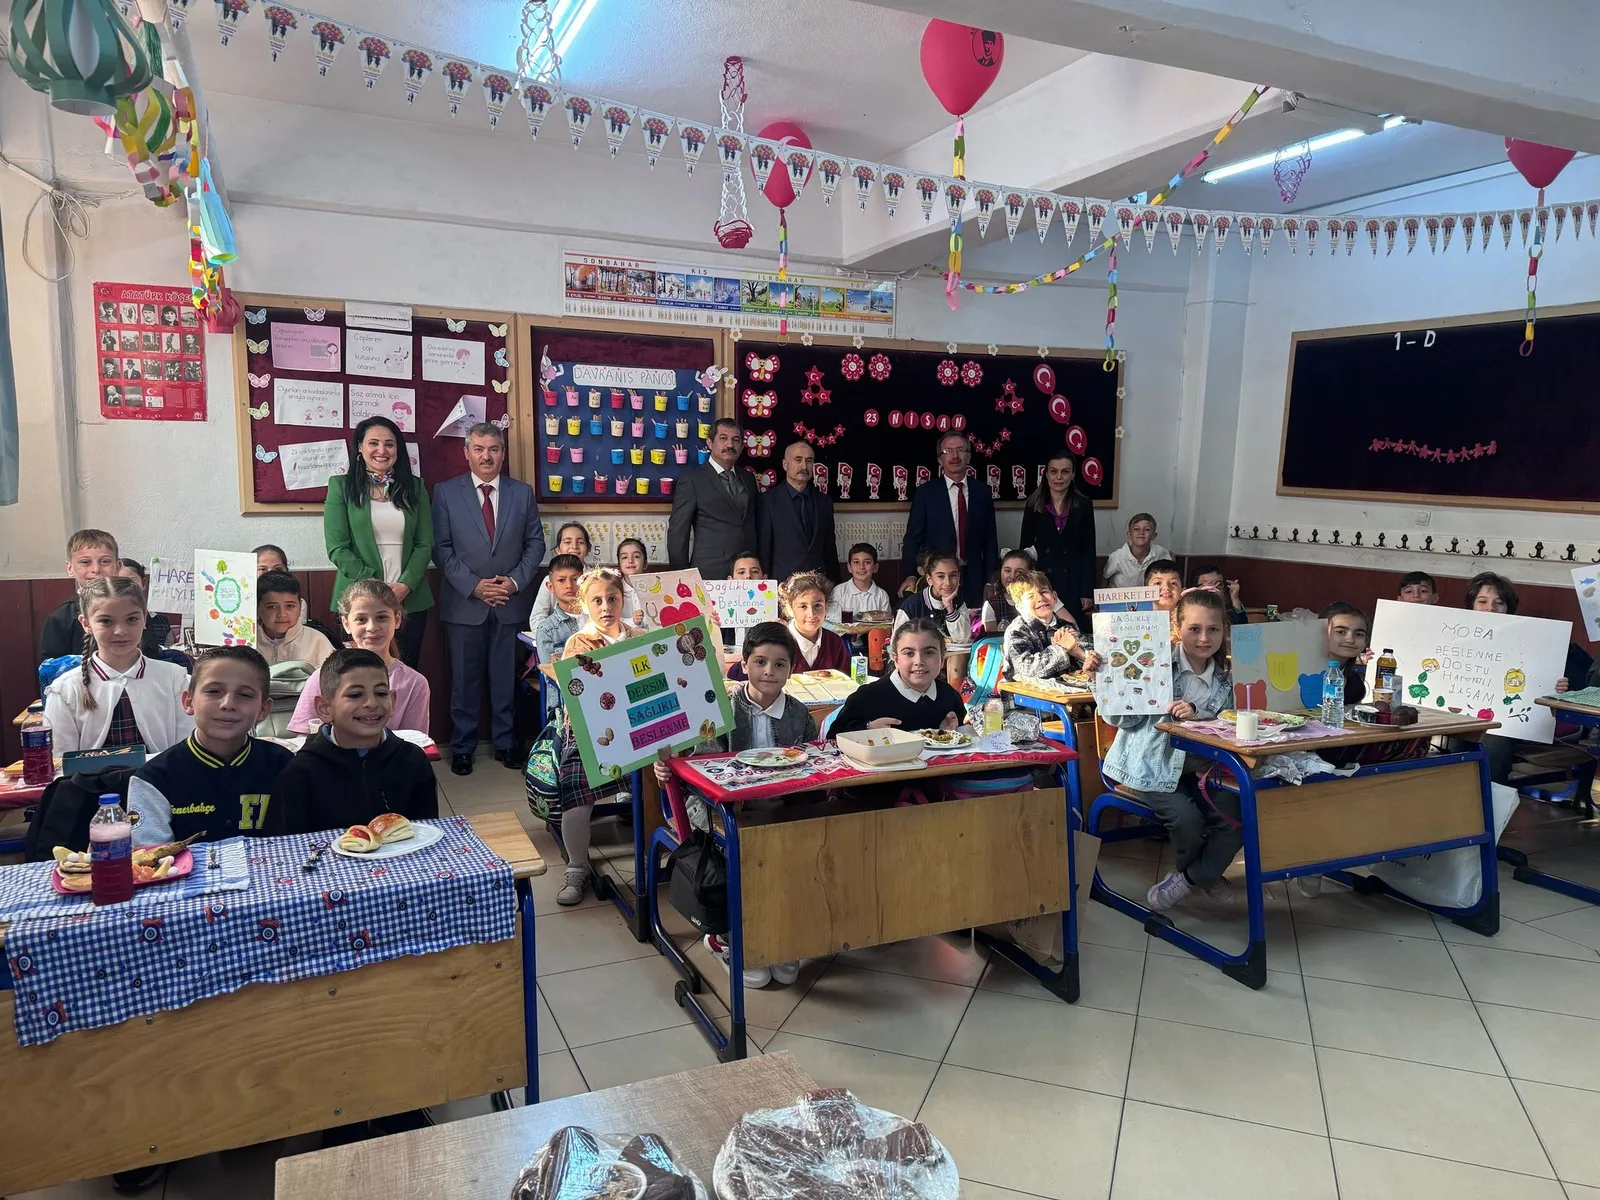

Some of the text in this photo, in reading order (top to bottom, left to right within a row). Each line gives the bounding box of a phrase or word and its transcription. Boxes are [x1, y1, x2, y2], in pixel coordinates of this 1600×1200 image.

[583, 257, 640, 268] SONBAHAR
[757, 274, 806, 284] İLKBHAR
[120, 289, 194, 304] ATATÜRK KÖŞES
[574, 366, 634, 385] DAVRANIŞ
[866, 412, 963, 429] 23 NİSAN
[594, 546, 601, 556] 5
[650, 545, 657, 556] 7
[157, 568, 194, 584] HARE
[1098, 590, 1157, 602] HAREKET ET
[631, 659, 651, 675] İLK
[1441, 657, 1490, 675] DOSTU
[627, 678, 669, 700] DERSİM
[628, 697, 680, 724] SAĞLIKLI
[631, 717, 690, 748] BESLENME
